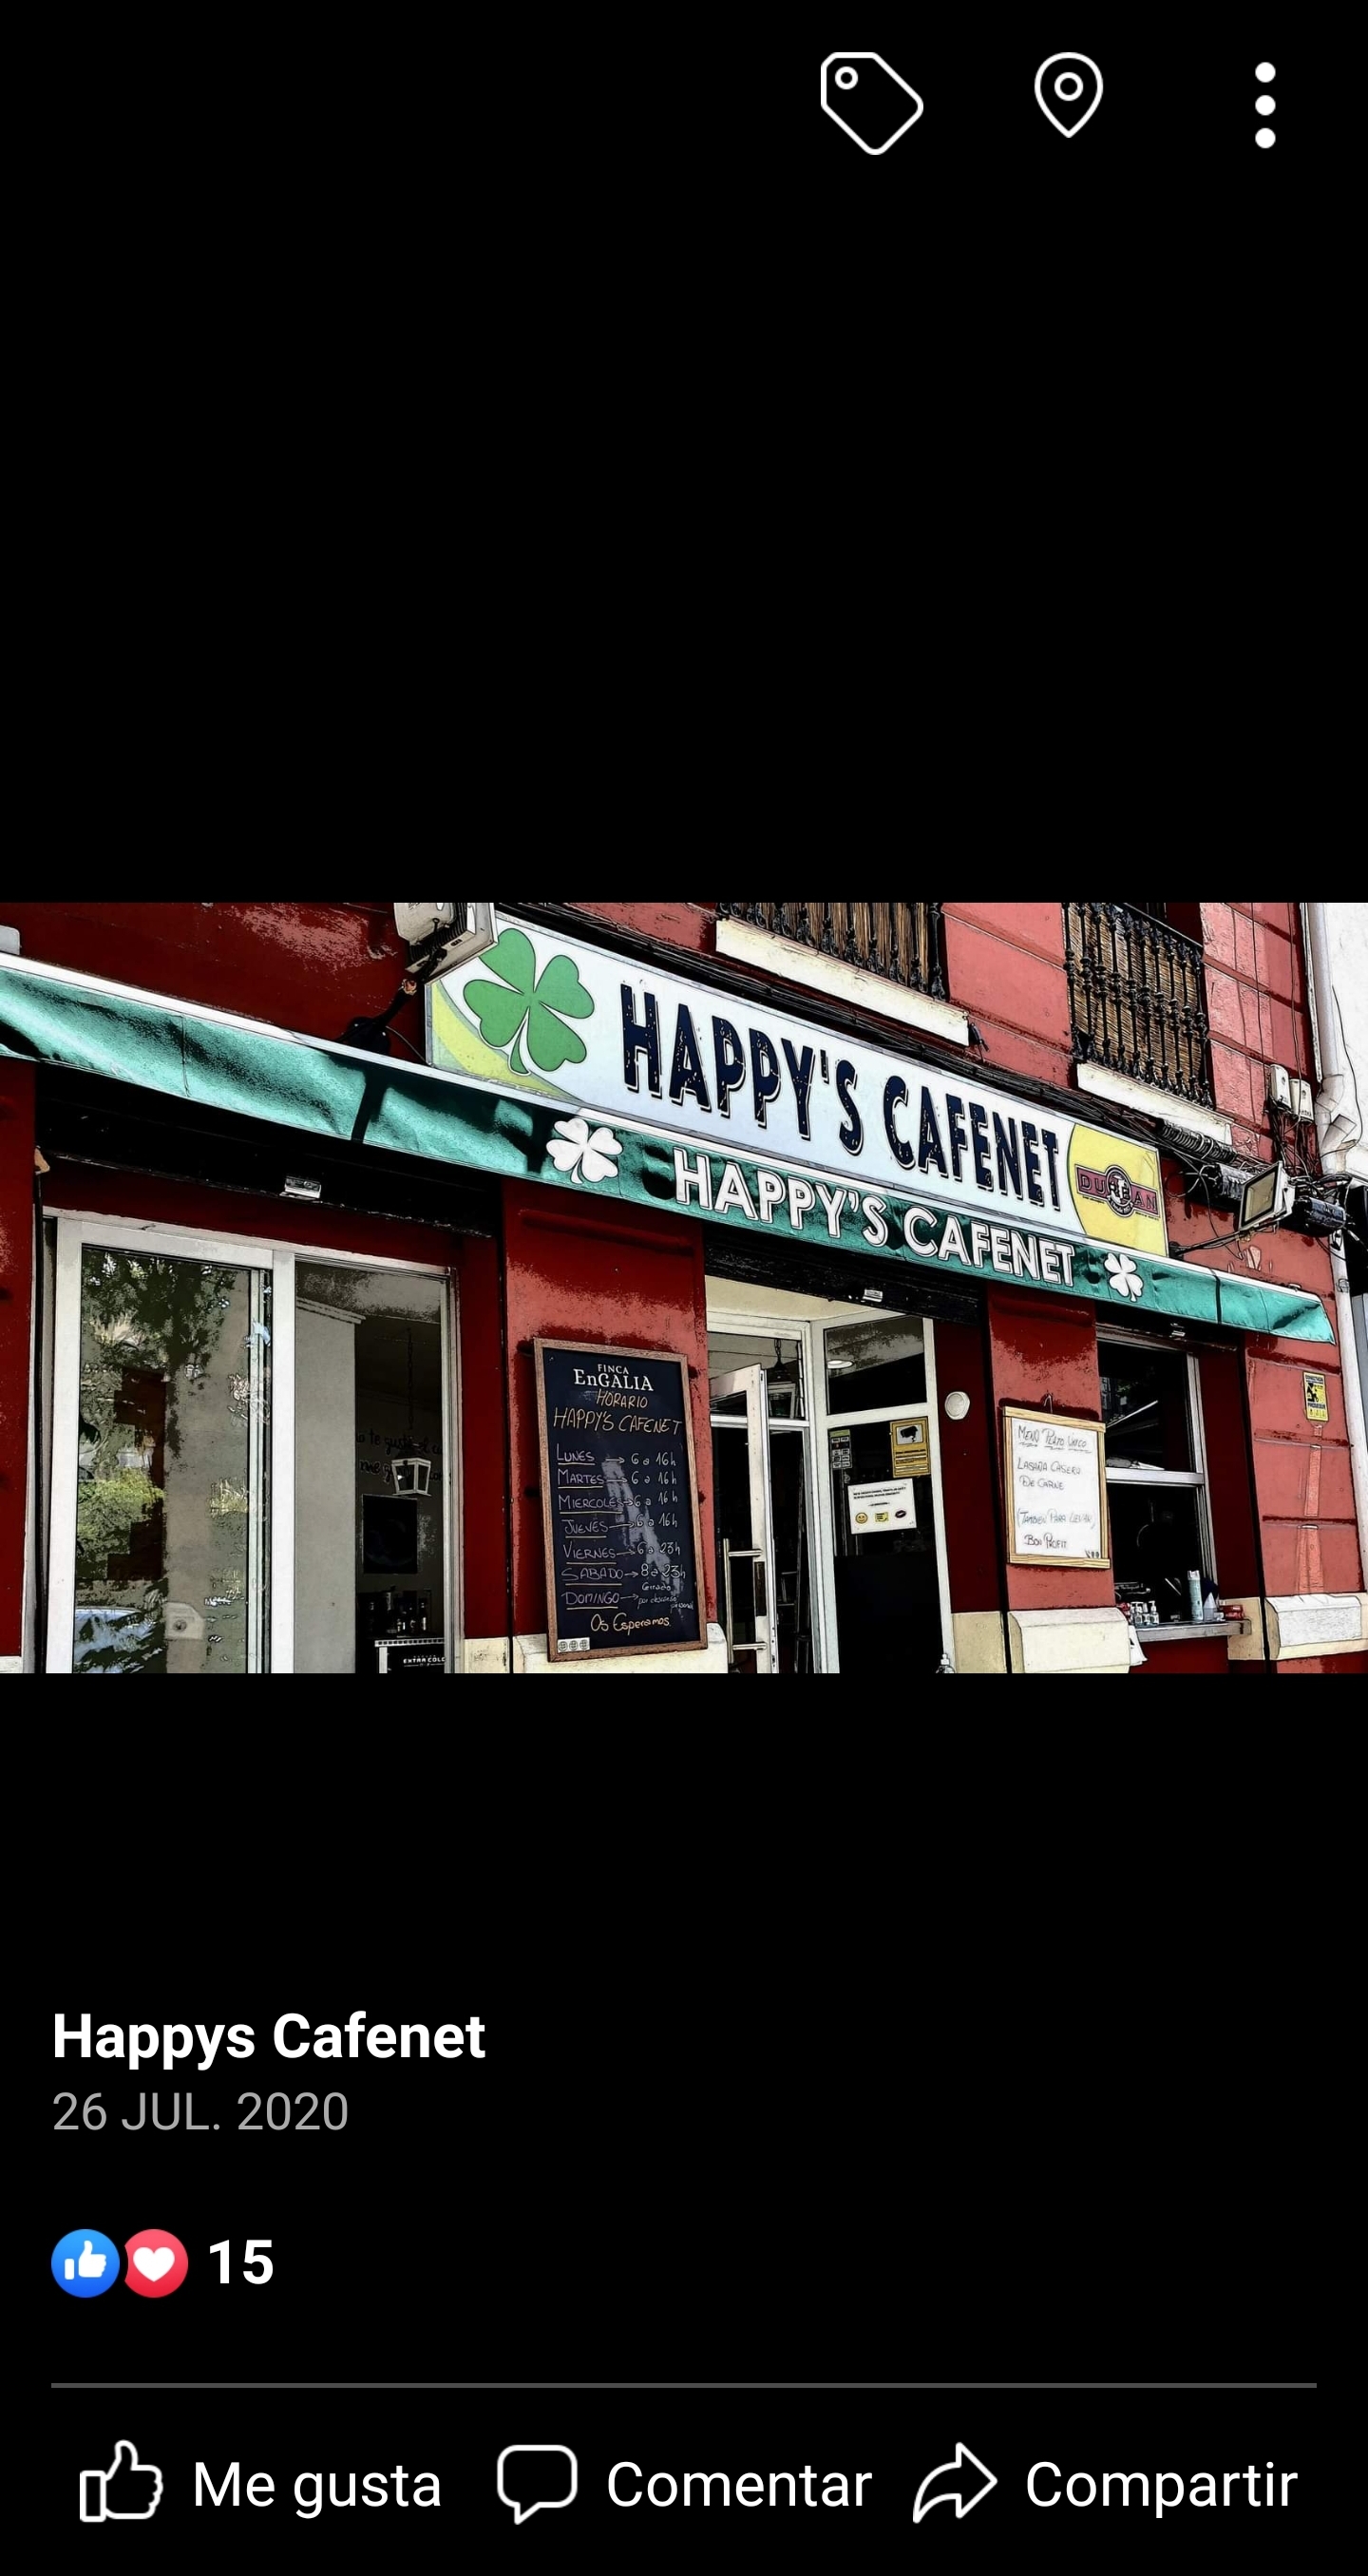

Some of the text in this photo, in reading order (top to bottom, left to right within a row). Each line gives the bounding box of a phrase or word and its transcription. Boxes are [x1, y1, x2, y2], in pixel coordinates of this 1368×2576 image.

[620, 983, 1060, 1212] HAPPY'S CAFENET
[673, 1146, 1075, 1287] HAPPY'S CAFENET
[598, 1364, 629, 1374] FINCA
[596, 1388, 648, 1409] HORARIO
[553, 1407, 683, 1435] HAPPY'S CAFENET
[557, 1443, 595, 1462] LUNES
[631, 1453, 639, 1464] 6
[558, 1468, 604, 1485] MARTES
[632, 1471, 639, 1484] 6
[559, 1494, 625, 1510] MIERCOLES
[634, 1495, 641, 1507] 6
[561, 1519, 608, 1535] JUEVES
[562, 1540, 617, 1559] VIERNES
[637, 1541, 647, 1555] 6
[560, 1567, 624, 1581] SABADO
[640, 1563, 649, 1576] 8
[560, 1591, 620, 1605] DOMINGO
[591, 1613, 609, 1631] Os
